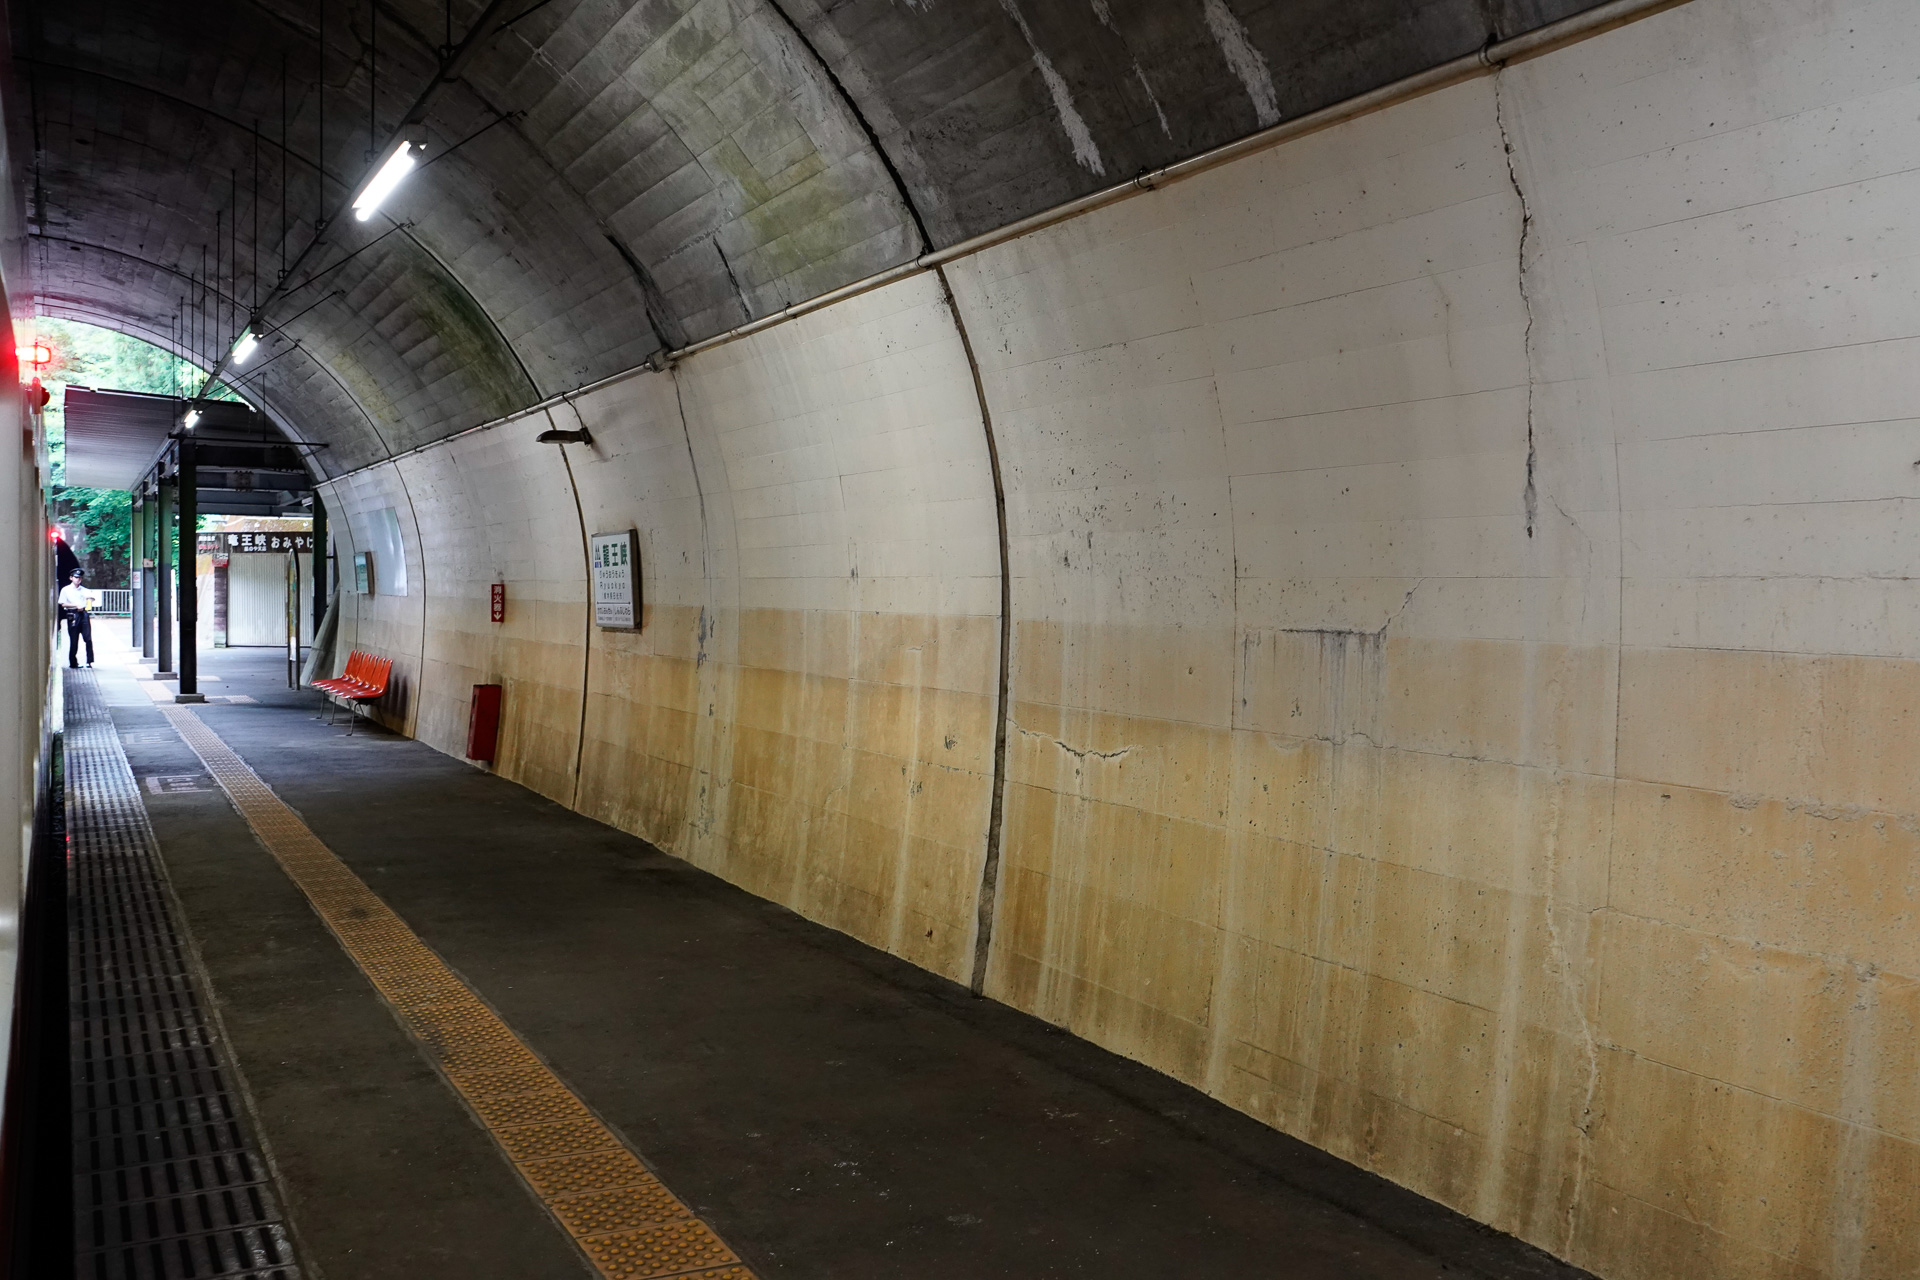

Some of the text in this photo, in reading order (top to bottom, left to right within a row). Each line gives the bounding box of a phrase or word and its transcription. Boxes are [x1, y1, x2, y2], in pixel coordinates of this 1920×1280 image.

[227, 534, 267, 546] 竜王峡
[602, 542, 628, 567] 龍王峡
[493, 585, 502, 612] 消火器
